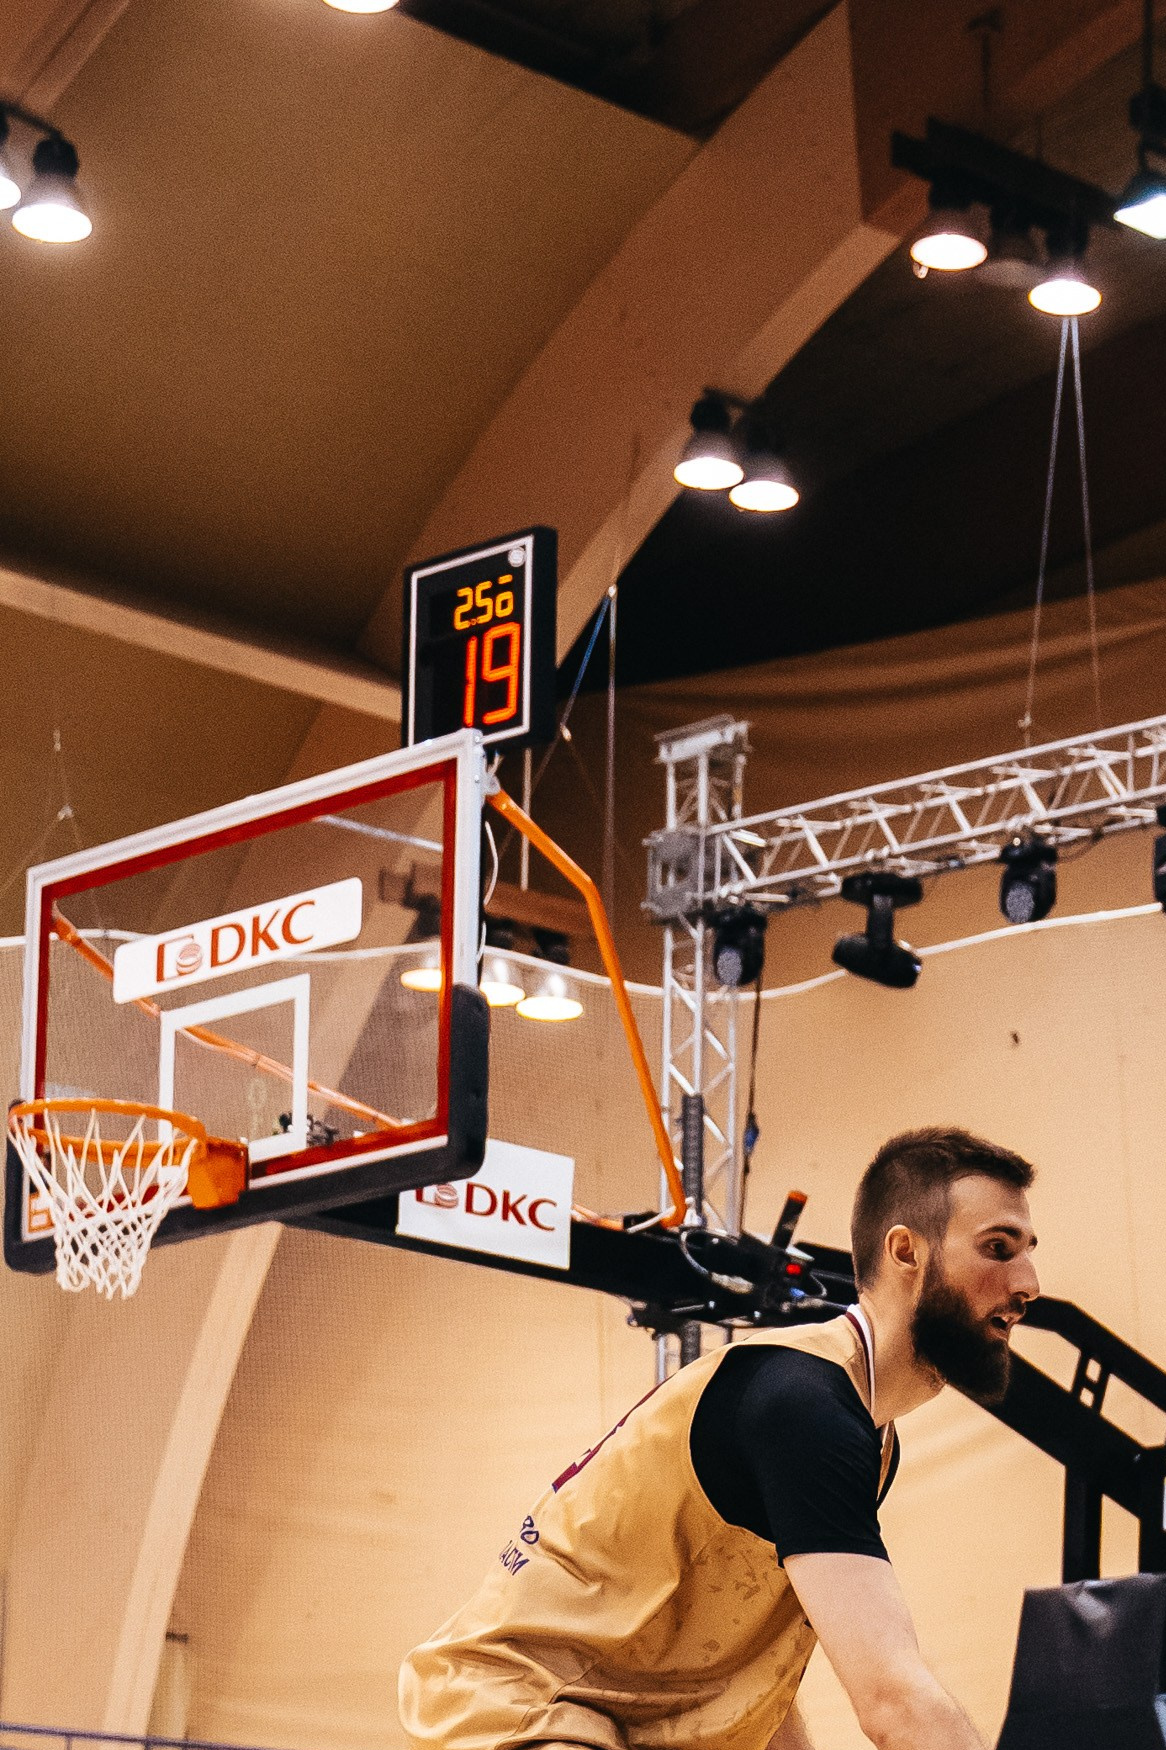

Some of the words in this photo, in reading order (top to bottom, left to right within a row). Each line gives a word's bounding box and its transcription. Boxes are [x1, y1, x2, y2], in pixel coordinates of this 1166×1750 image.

[463, 621, 522, 728] 19
[209, 899, 316, 969] DKC
[463, 1194, 559, 1233] DKC
